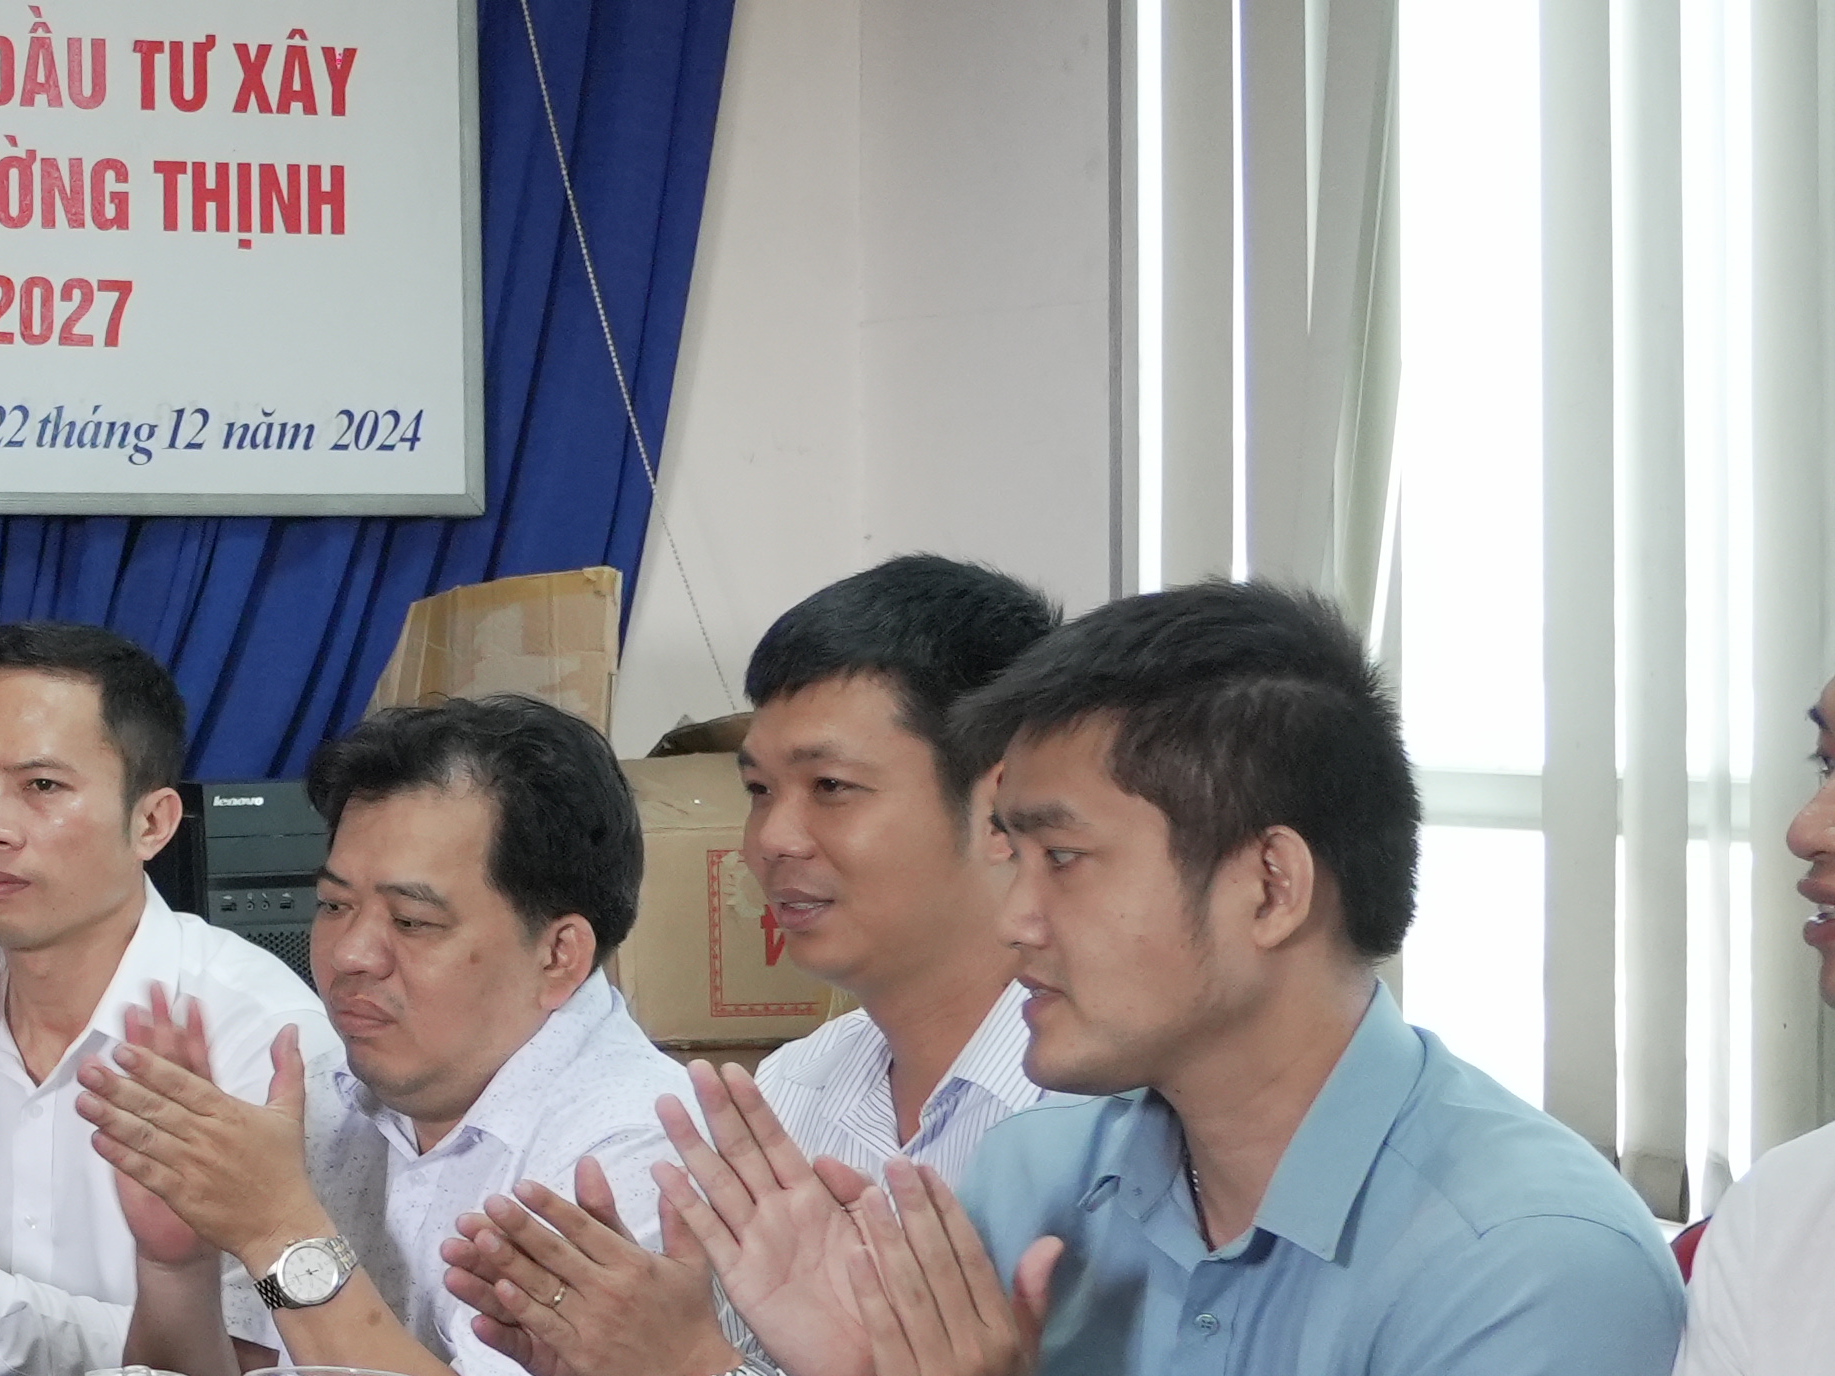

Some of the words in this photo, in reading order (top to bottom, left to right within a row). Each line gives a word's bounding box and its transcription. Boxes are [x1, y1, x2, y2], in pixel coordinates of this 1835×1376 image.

[132, 34, 216, 112] TƯ
[232, 28, 358, 116] XÂY
[154, 160, 345, 249] THỊNH
[36, 405, 158, 465] tháng
[163, 408, 209, 450] 12
[223, 408, 315, 450] năm
[329, 409, 423, 451] 2024
[212, 795, 265, 807] lenovo
